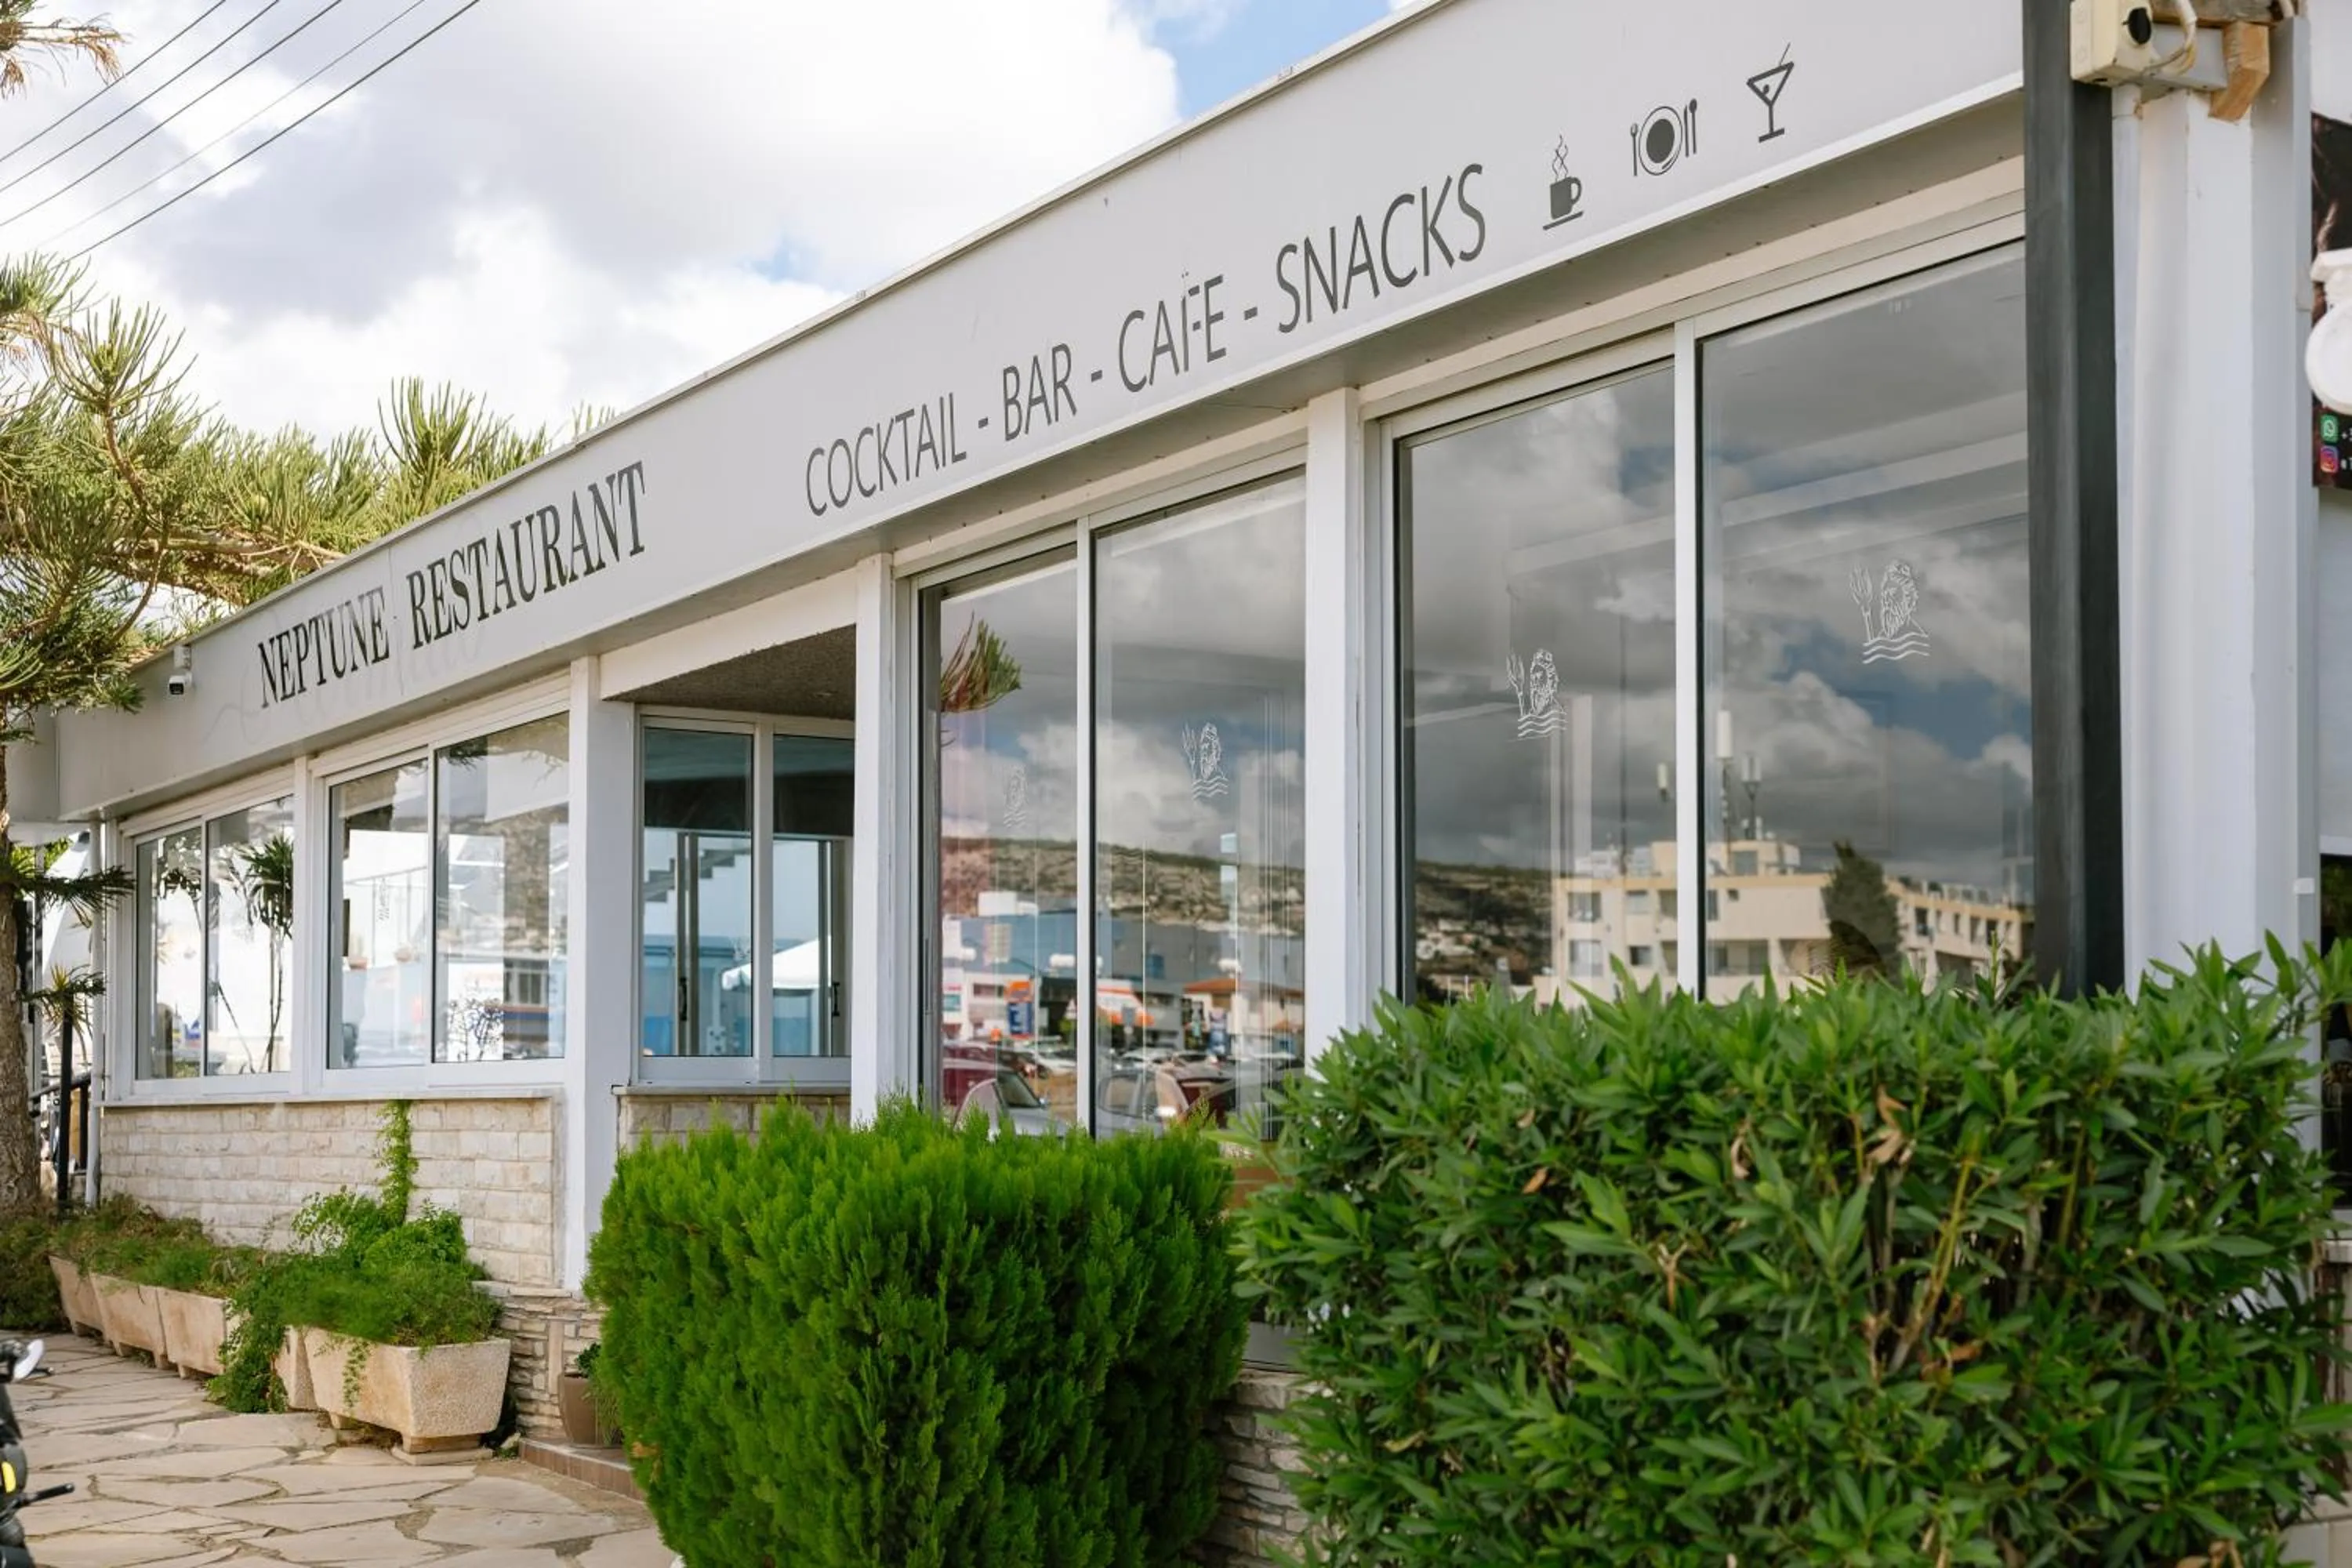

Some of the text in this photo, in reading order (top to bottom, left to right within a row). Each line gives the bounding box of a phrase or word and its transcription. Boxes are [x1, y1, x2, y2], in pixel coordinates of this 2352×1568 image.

[806, 393, 967, 517] COCKTAIL
[1003, 343, 1077, 441] BAR
[1119, 274, 1227, 393] CAFE
[1276, 163, 1486, 333] SNACKS
[258, 460, 646, 708] NEPTUNE RESTAURANT
